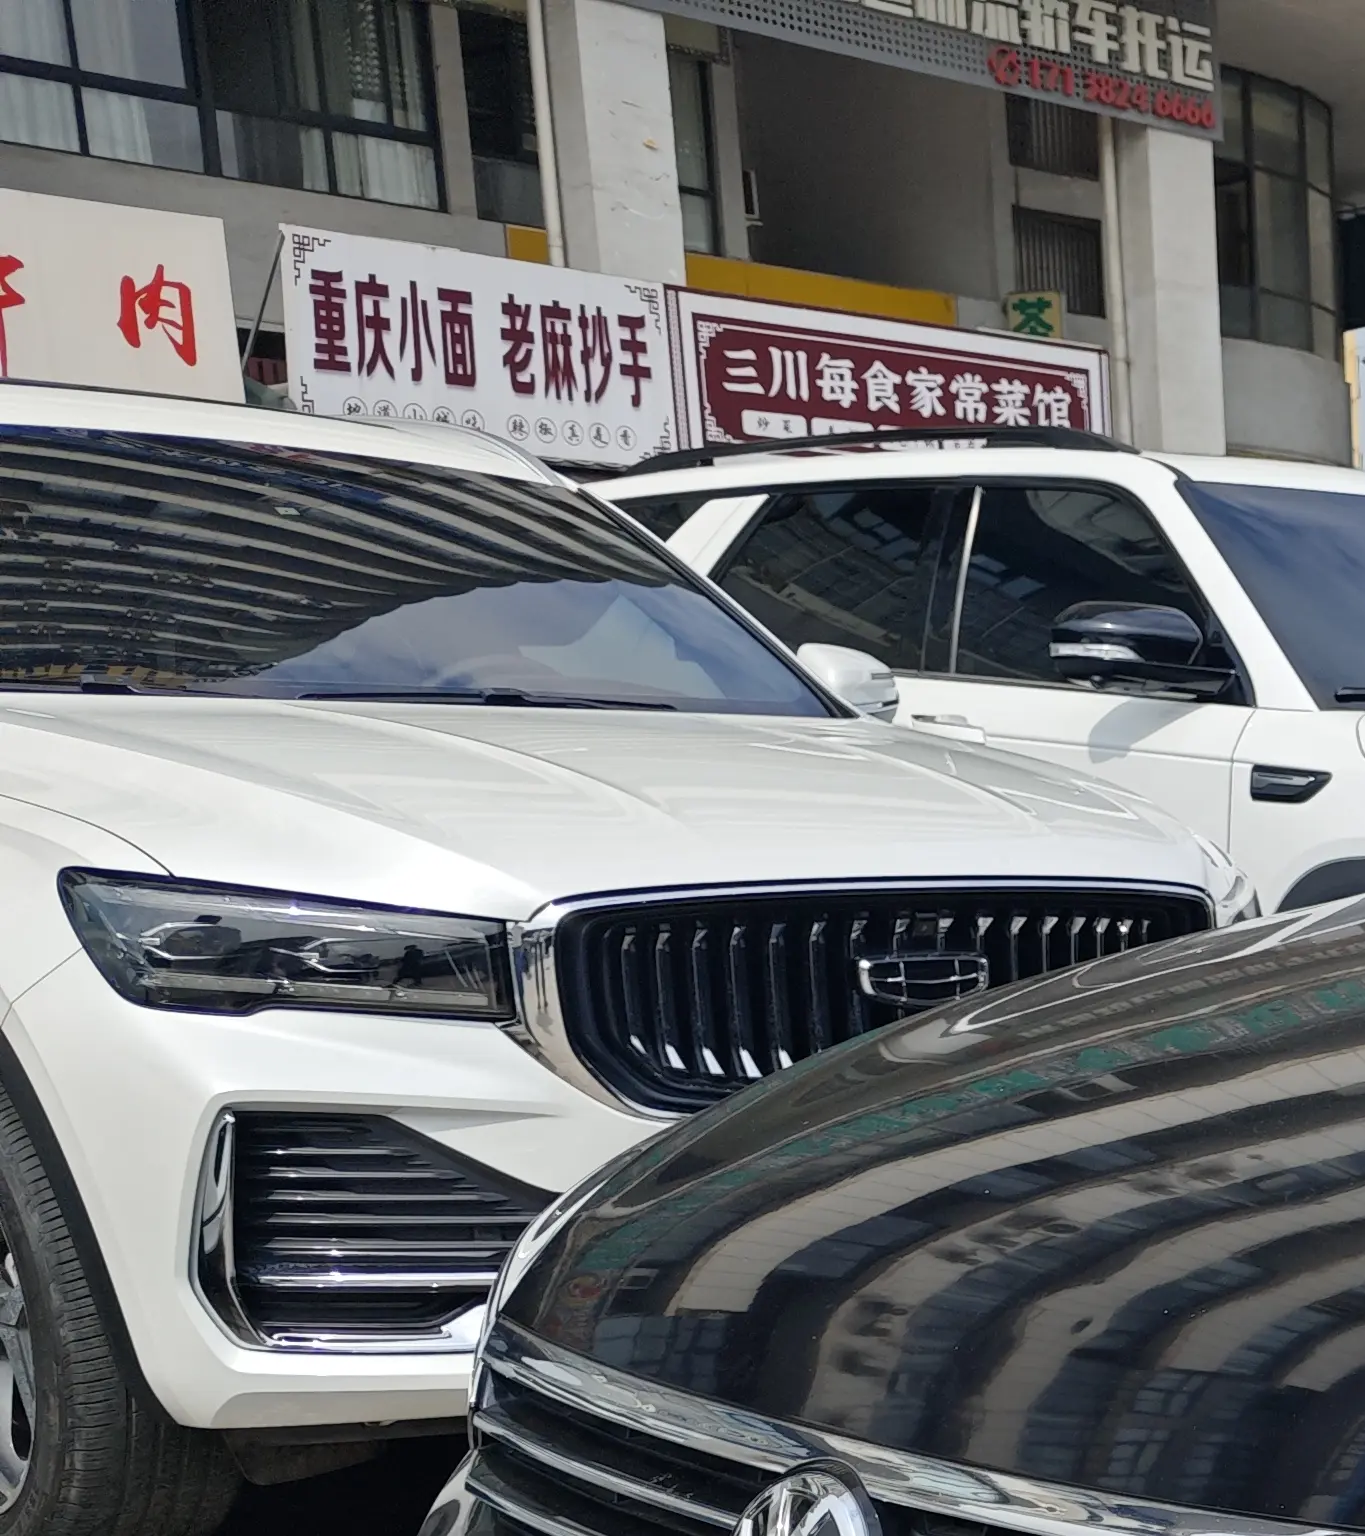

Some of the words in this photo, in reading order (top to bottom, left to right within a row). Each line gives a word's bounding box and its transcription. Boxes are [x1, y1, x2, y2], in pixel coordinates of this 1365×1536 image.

[308, 268, 478, 388] 重庆小面
[500, 292, 654, 408] 老麻抄手
[721, 345, 1073, 428] 三川每食家常菜馆
